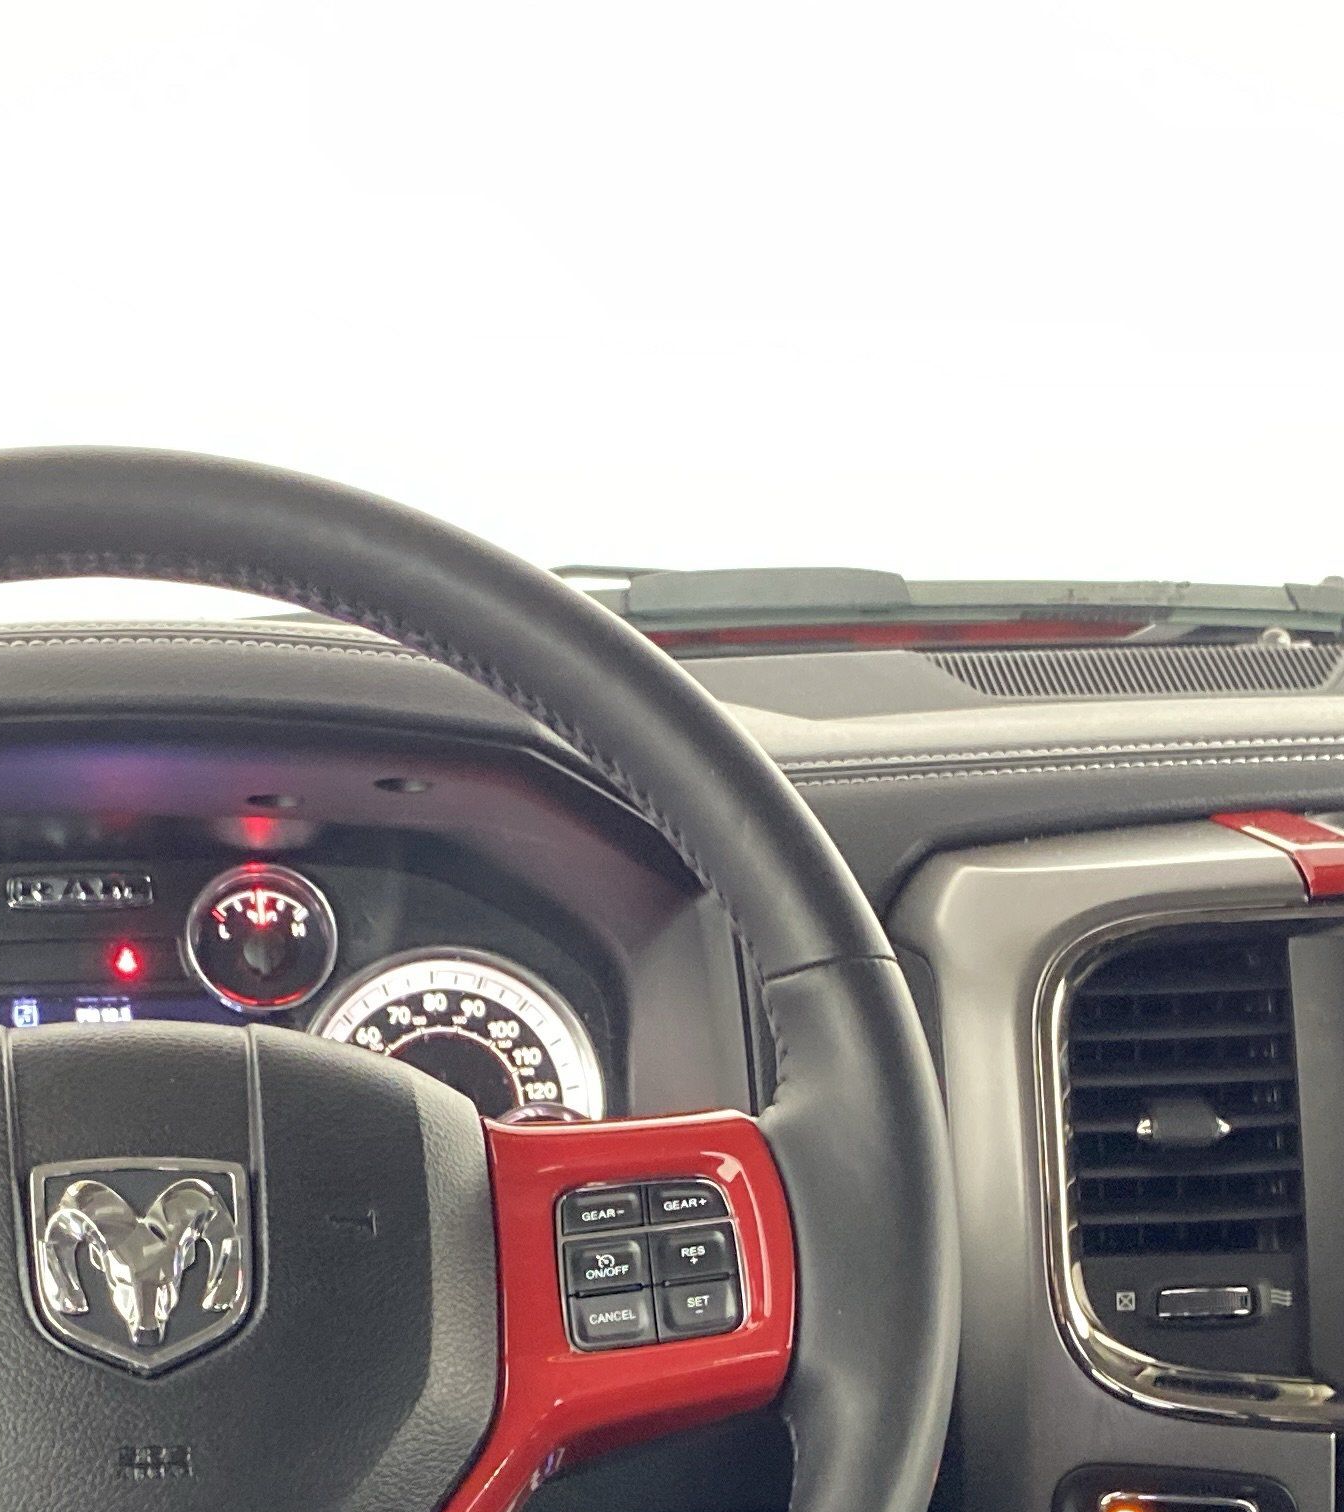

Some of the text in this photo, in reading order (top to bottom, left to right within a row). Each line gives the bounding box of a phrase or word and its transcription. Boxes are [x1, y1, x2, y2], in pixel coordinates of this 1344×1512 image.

[421, 992, 449, 1013] 80
[460, 998, 487, 1018] 90
[387, 1005, 412, 1026] 70
[356, 1025, 383, 1046] 60
[486, 1019, 521, 1040] 100
[511, 1046, 543, 1067] 110
[523, 1081, 559, 1101] 120
[680, 1245, 706, 1258] RES
[585, 1264, 630, 1281] ON/OFF
[686, 1294, 710, 1309] SET
[588, 1309, 637, 1325] CANCEL
